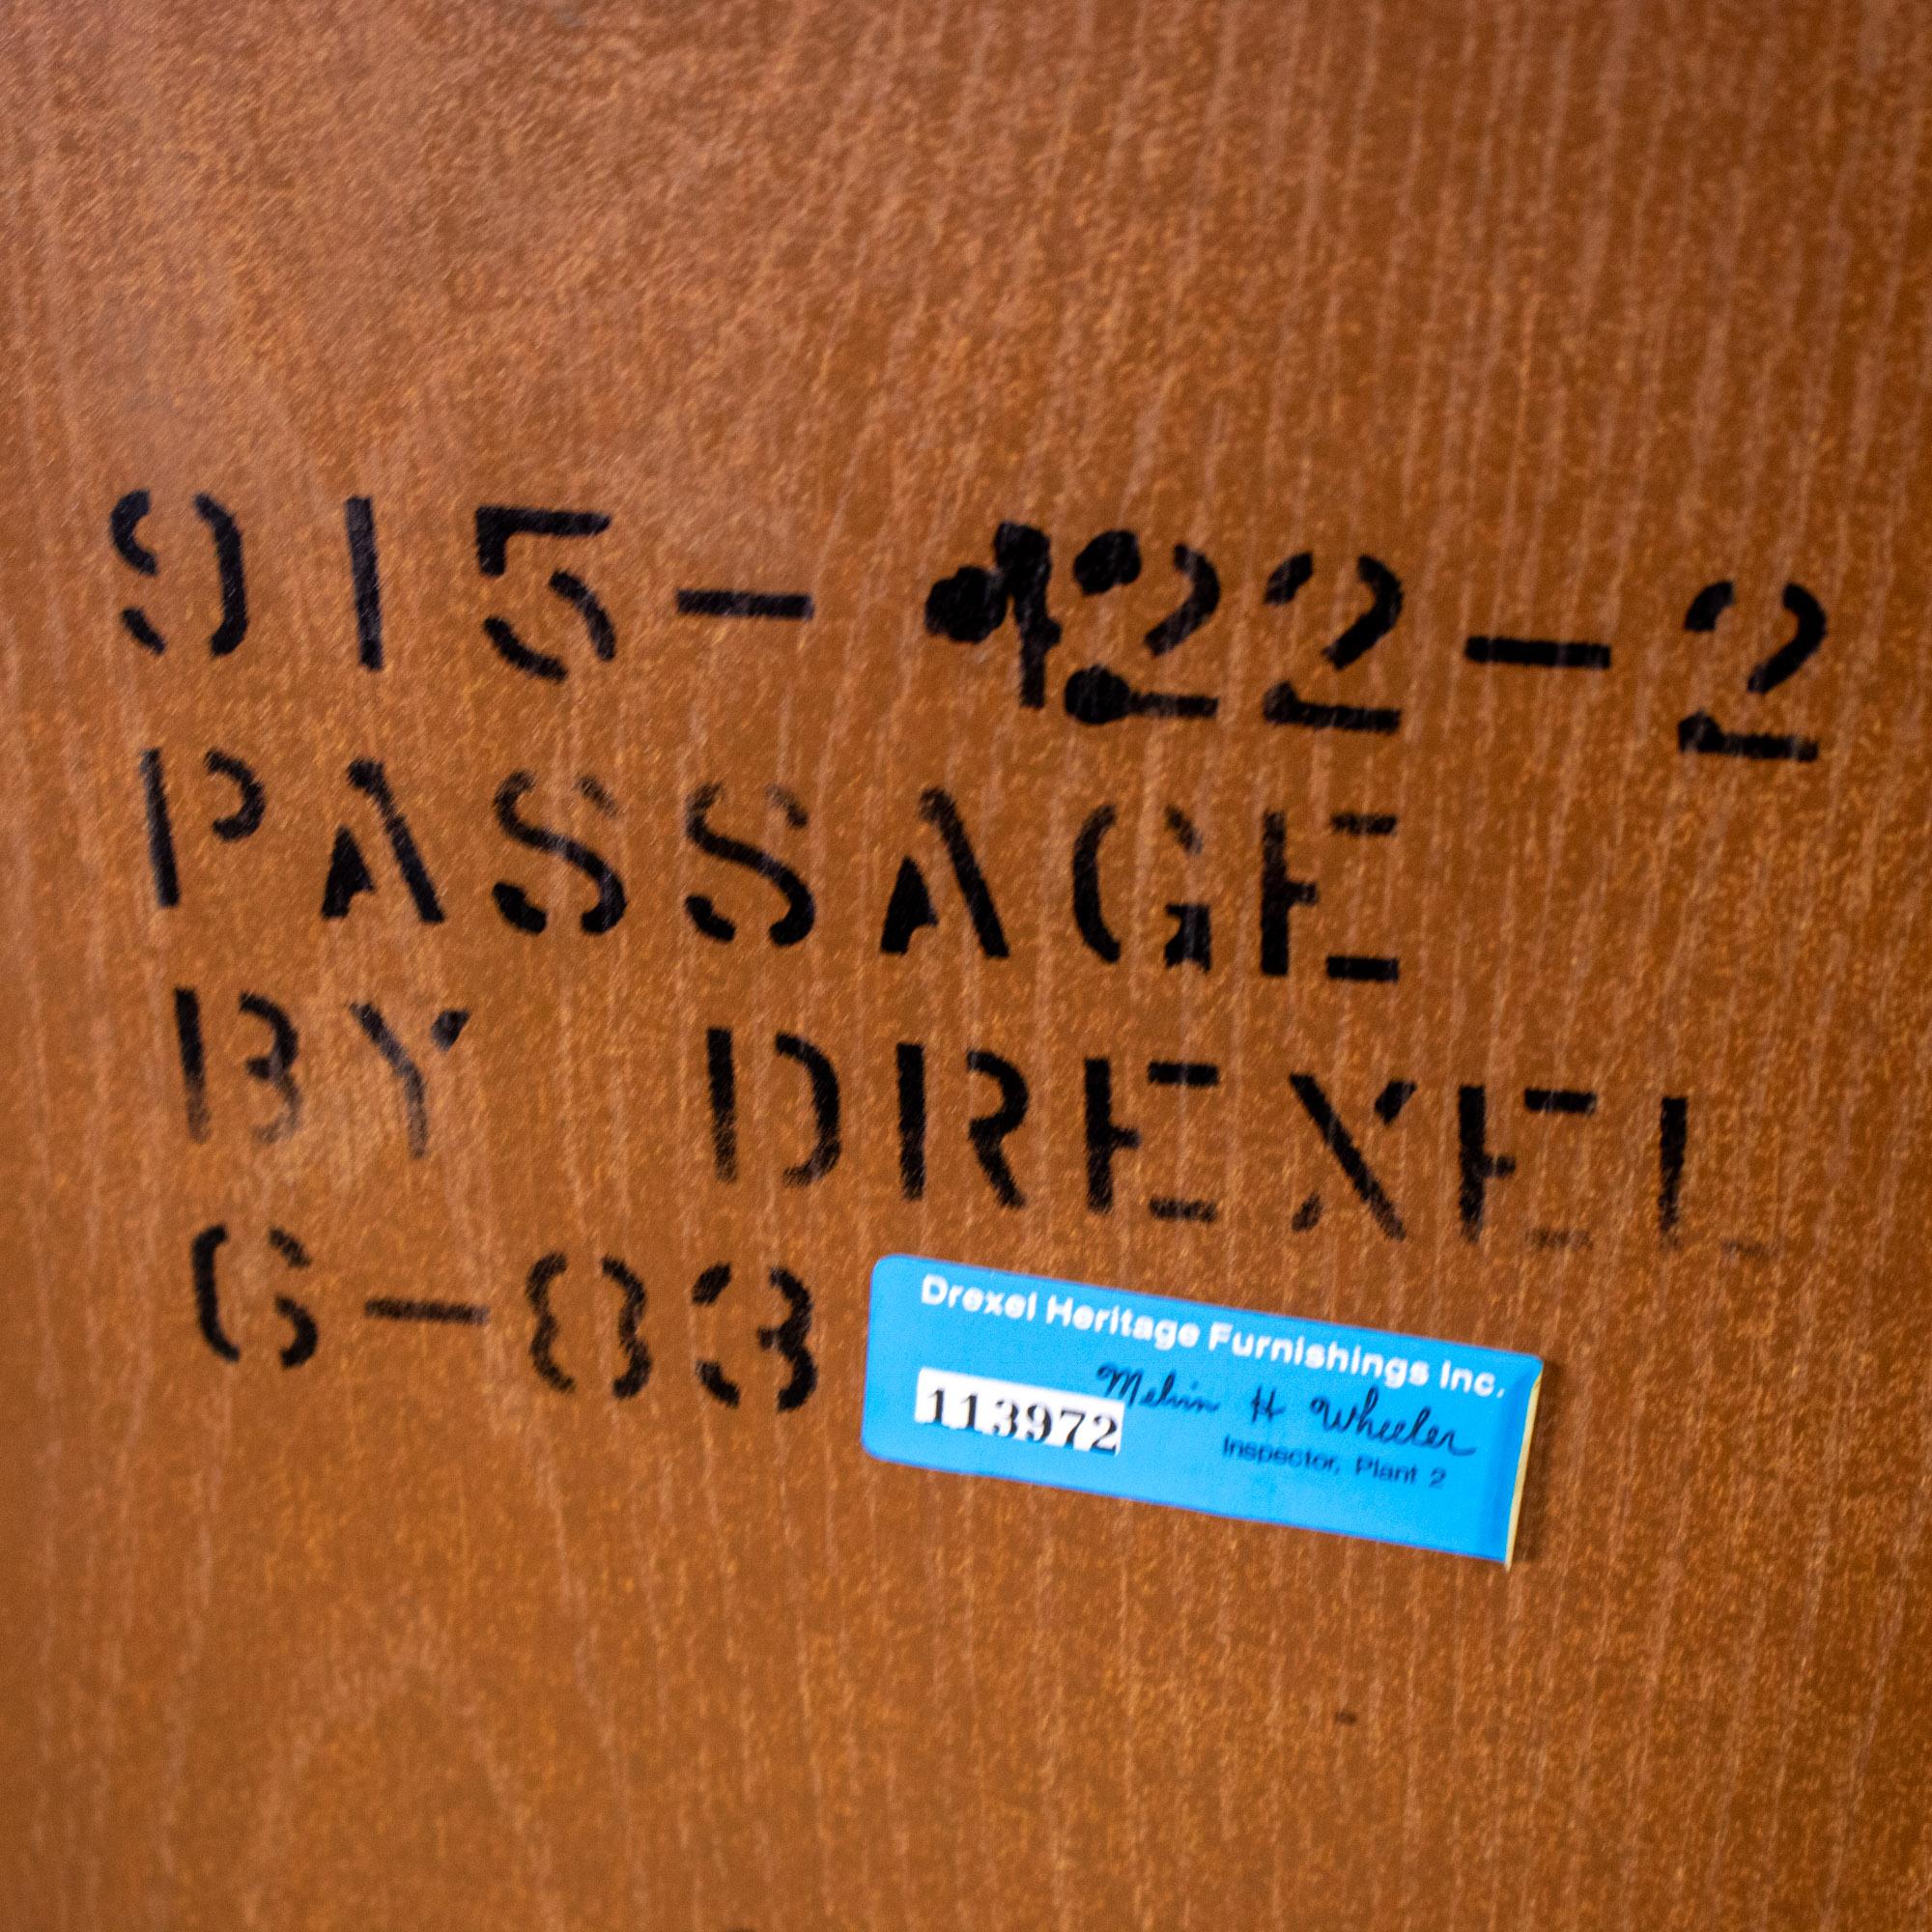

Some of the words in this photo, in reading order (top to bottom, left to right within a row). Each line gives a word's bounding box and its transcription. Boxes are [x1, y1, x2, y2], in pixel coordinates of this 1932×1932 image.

[141, 746, 1400, 983] PASSAGE
[175, 985, 469, 1160] BY
[705, 1026, 1771, 1260] DREXEL
[191, 1223, 817, 1412] 6-83
[921, 1273, 1038, 1321] Drexel
[1045, 1294, 1201, 1351] Heritage
[1208, 1321, 1431, 1389] Furnishings
[928, 1388, 1118, 1455] 113972
[1095, 1360, 1221, 1413] Melvin
[1309, 1383, 1476, 1457] Wheeler
[1222, 1434, 1341, 1475] Inspector,
[1354, 1455, 1418, 1484] Plant
[1428, 1466, 1447, 1489] 2
